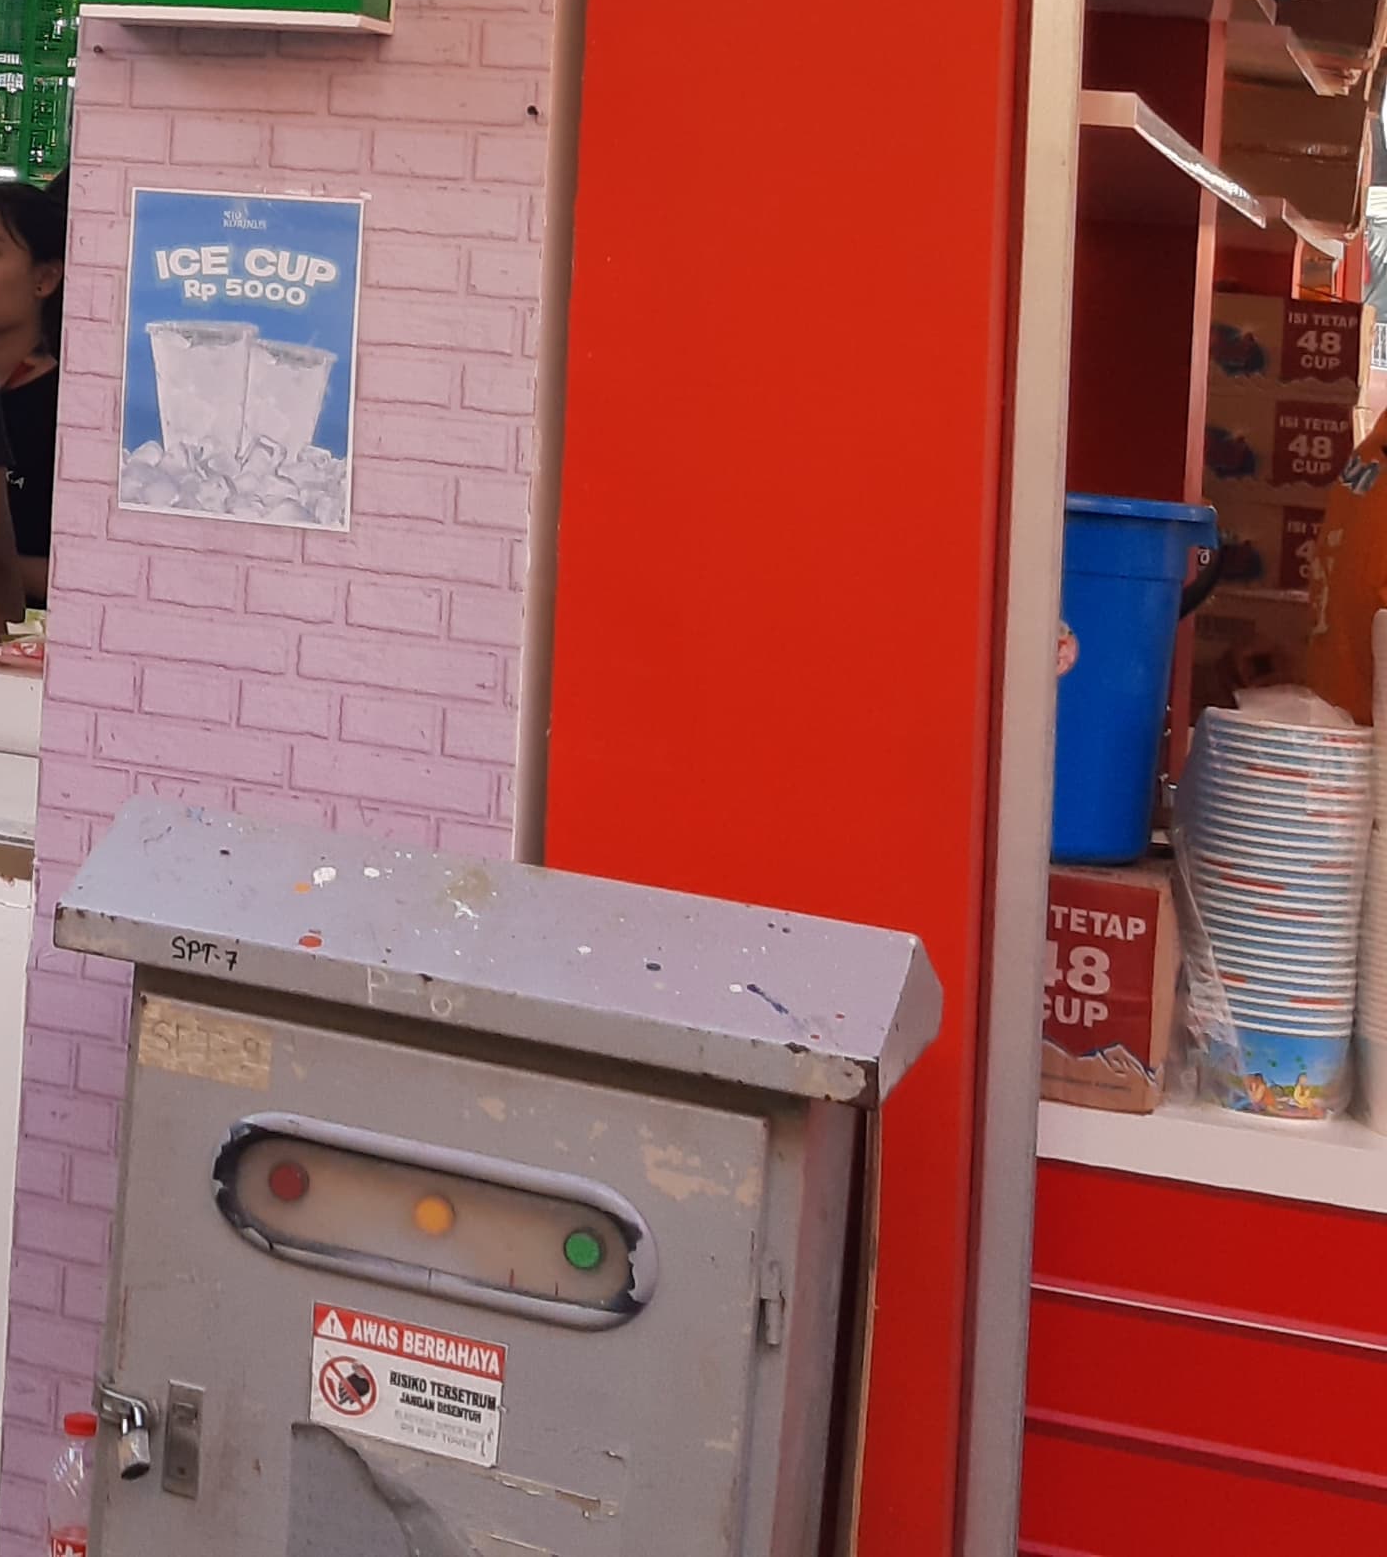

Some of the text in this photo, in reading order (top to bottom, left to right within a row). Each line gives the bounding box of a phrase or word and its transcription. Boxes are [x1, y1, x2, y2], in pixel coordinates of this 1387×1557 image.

[155, 246, 337, 287] ICE CUP
[184, 279, 306, 306] Rp 5000
[1288, 312, 1358, 328] ISI TETAP
[1297, 330, 1341, 355] 48
[1301, 354, 1341, 370] CUP
[1279, 416, 1348, 433] ISI TETAP
[1288, 434, 1332, 460] 48
[1292, 459, 1331, 474] CUP
[1050, 904, 1147, 941] TETAP
[171, 935, 239, 972] SPT-7
[351, 1317, 500, 1376] AWAS BERBAHAYA
[389, 1370, 497, 1411] RISIKO TERSETRUM
[399, 1392, 482, 1424] JANGAN DISENTUH
